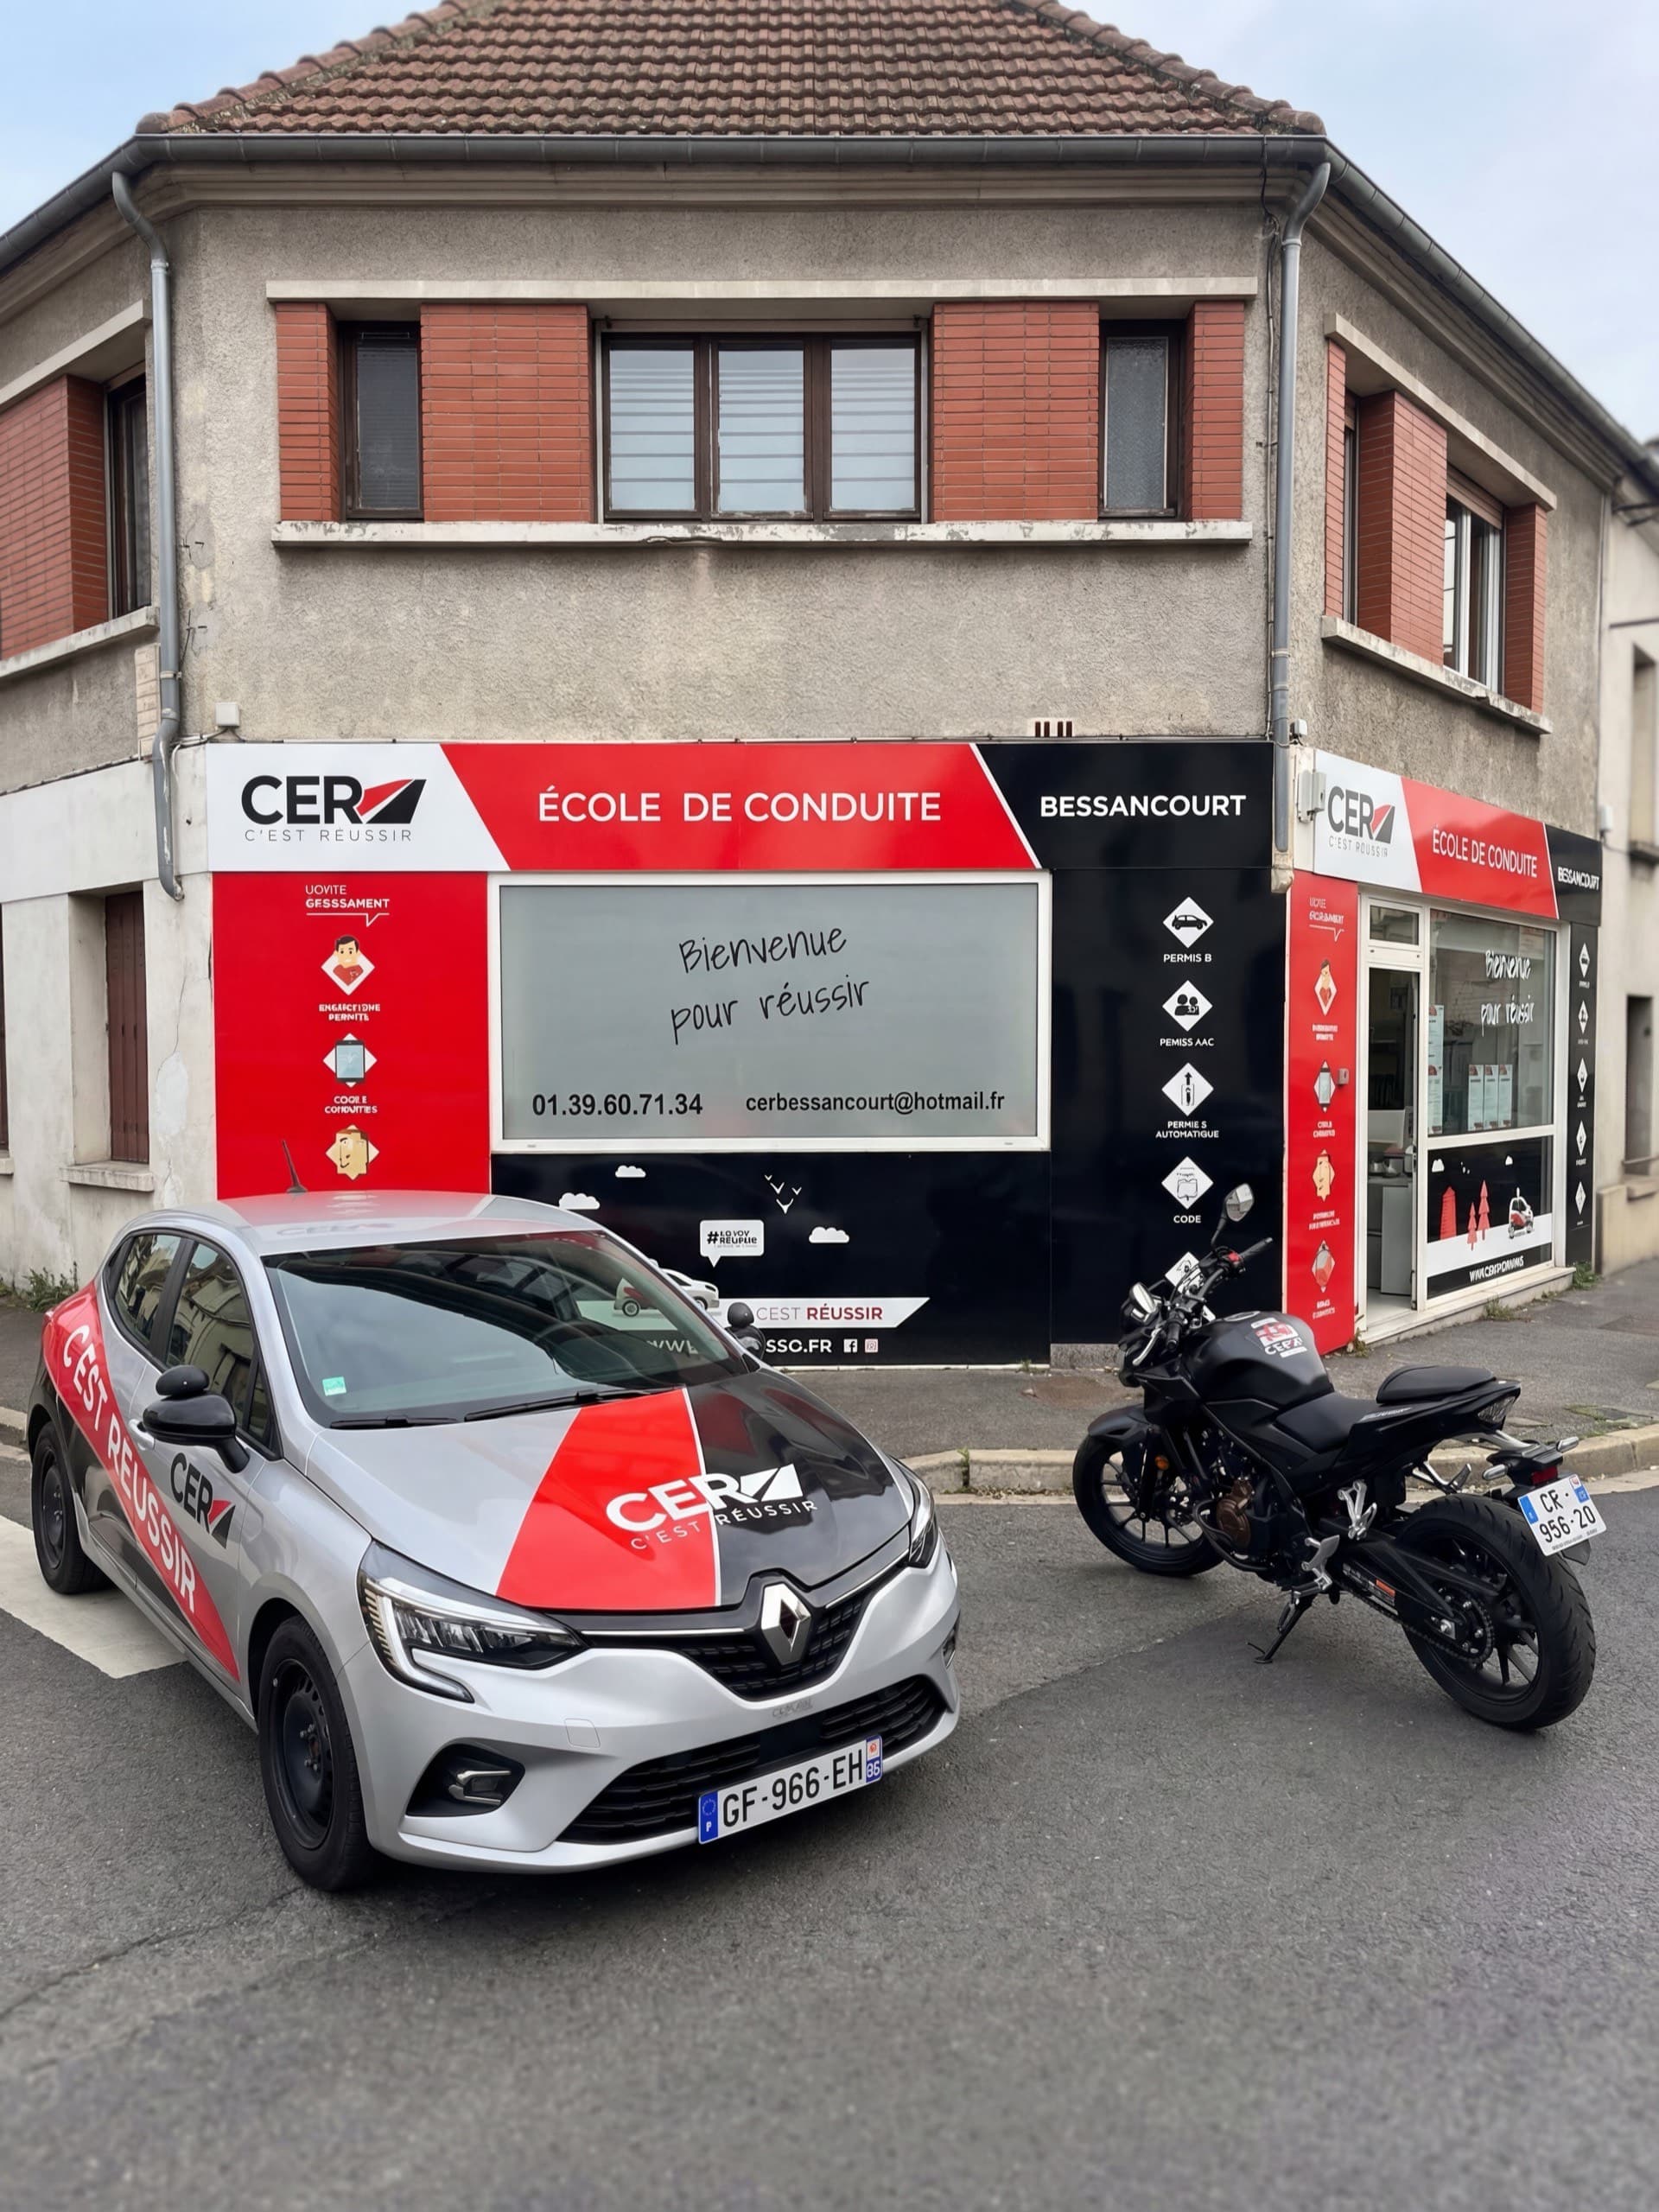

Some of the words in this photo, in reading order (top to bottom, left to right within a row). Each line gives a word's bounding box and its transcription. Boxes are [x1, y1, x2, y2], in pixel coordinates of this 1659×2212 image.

[241, 775, 364, 825] CER
[537, 785, 662, 823] ÉCOLE
[683, 791, 733, 822] DE
[743, 791, 942, 822] CONDUITE
[1039, 794, 1248, 817] BESSANCOURT
[1327, 785, 1374, 840] CER
[245, 829, 305, 842] C'EST
[319, 827, 412, 842] RÉUSSIR
[1471, 839, 1486, 866] DE
[1487, 844, 1538, 879] CONDUITE
[678, 927, 848, 974] Bienvenue
[1163, 953, 1202, 963] PERMIS
[1204, 953, 1212, 963] B
[671, 1000, 739, 1046] pour
[759, 974, 870, 1020] réussir
[1195, 1038, 1215, 1047] AAC
[531, 1093, 703, 1116] 01.39.60.71.34
[746, 1091, 1005, 1112] cerbessancourt@hotmail.fr
[1173, 1215, 1202, 1224] CODE
[805, 1303, 883, 1320] RÉUSSIR
[170, 1452, 214, 1534] CER
[606, 1472, 760, 1533] CER
[630, 1520, 702, 1550] C'EST
[722, 1748, 863, 1827] GF-966-EH
